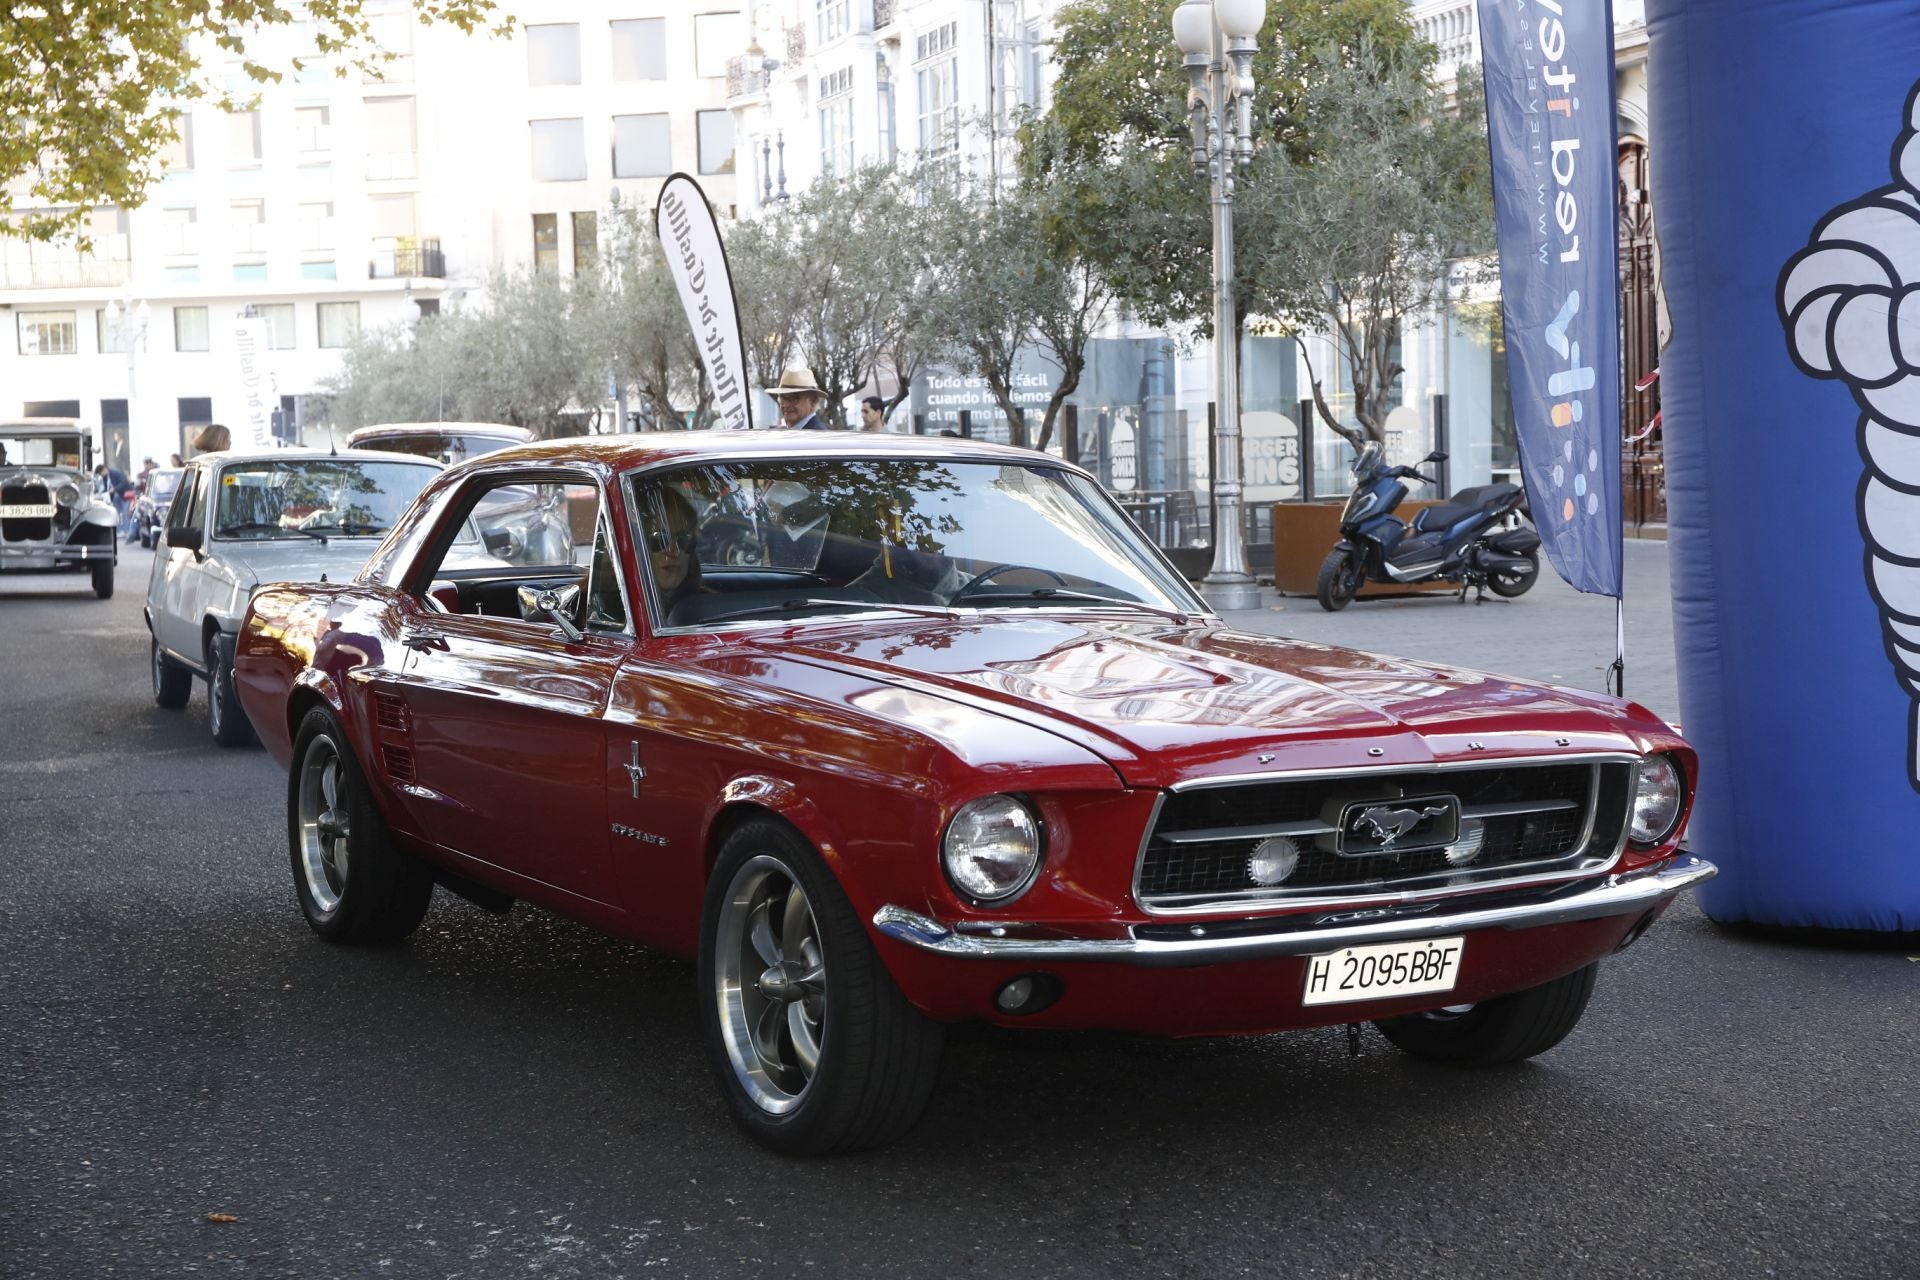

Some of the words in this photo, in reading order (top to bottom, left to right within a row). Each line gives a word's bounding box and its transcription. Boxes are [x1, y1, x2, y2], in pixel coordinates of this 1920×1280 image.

[926, 375, 962, 389] Todo
[964, 378, 981, 388] es
[1016, 373, 1048, 387] fácil
[927, 390, 980, 405] cuando
[982, 389, 1052, 403] halamos
[928, 408, 941, 421] el
[945, 408, 992, 421] mmo
[1243, 438, 1298, 457] RGER
[1243, 457, 1299, 485] ING
[1311, 960, 1331, 993] H
[1339, 948, 1458, 990] 2095BBF
